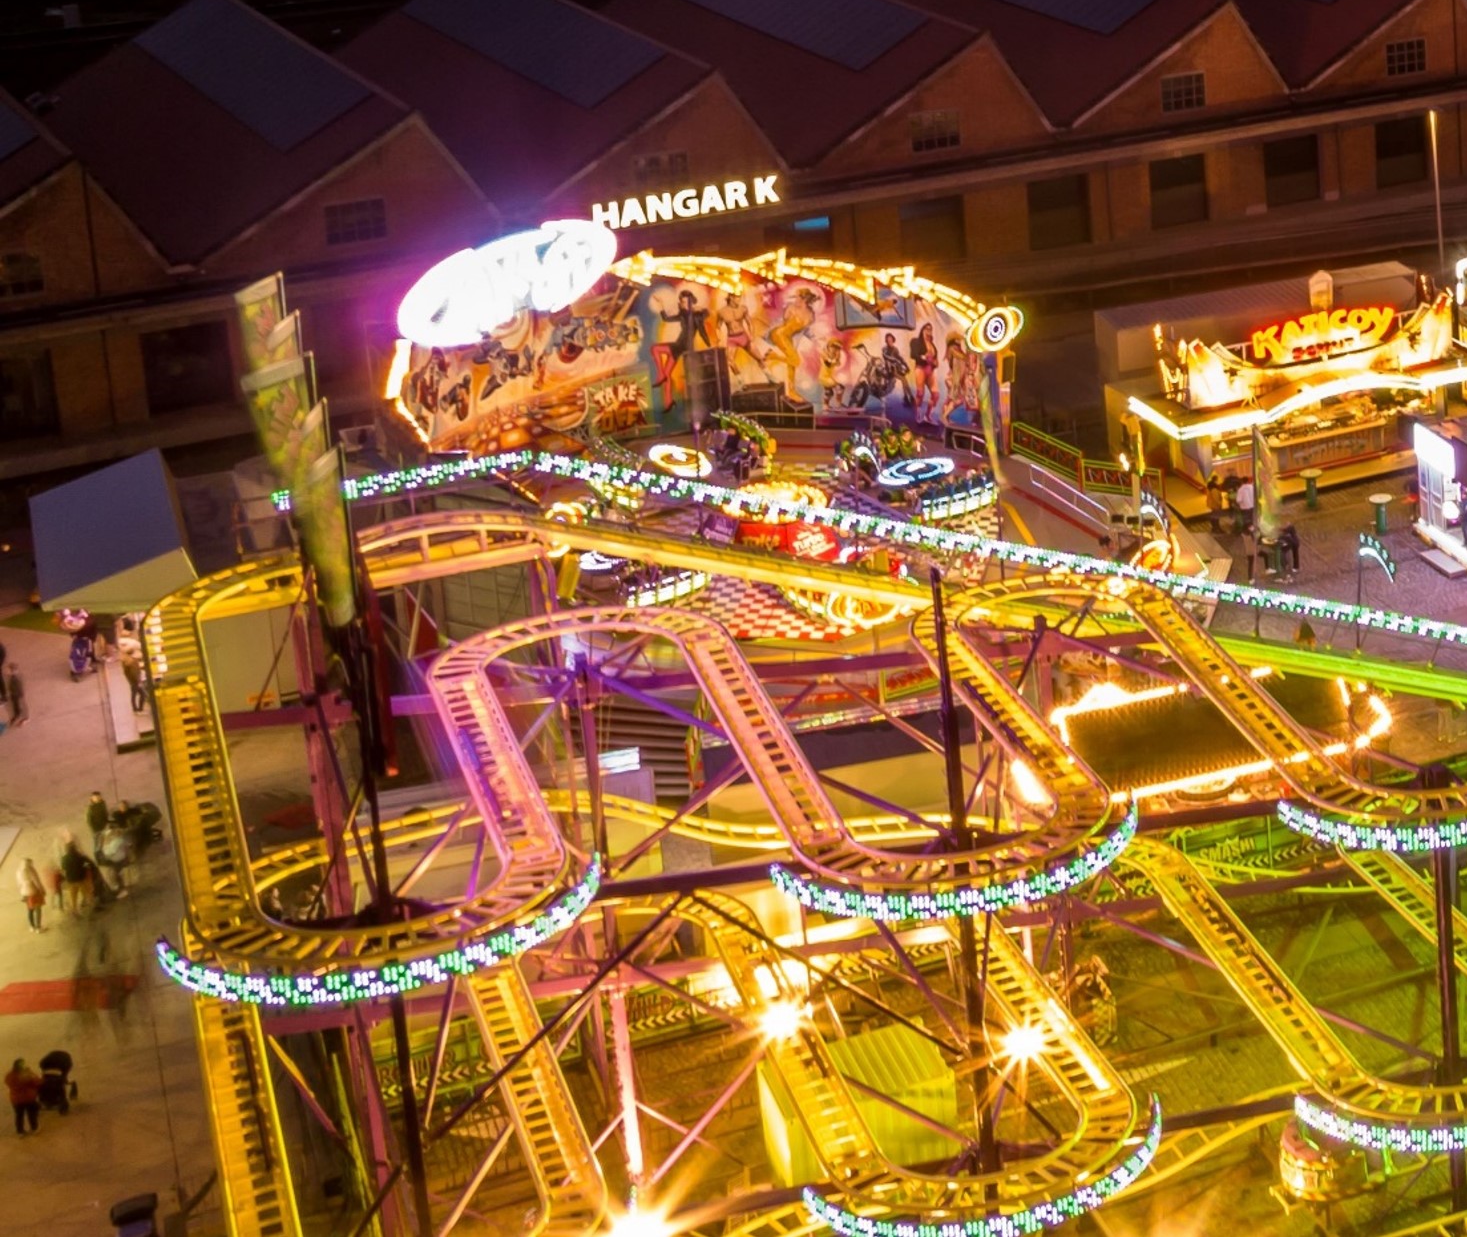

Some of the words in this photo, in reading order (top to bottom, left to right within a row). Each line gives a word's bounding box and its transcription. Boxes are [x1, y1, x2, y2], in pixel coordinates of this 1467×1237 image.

[592, 181, 749, 230] HANGAR
[754, 175, 781, 205] K
[593, 383, 638, 406] TAKE
